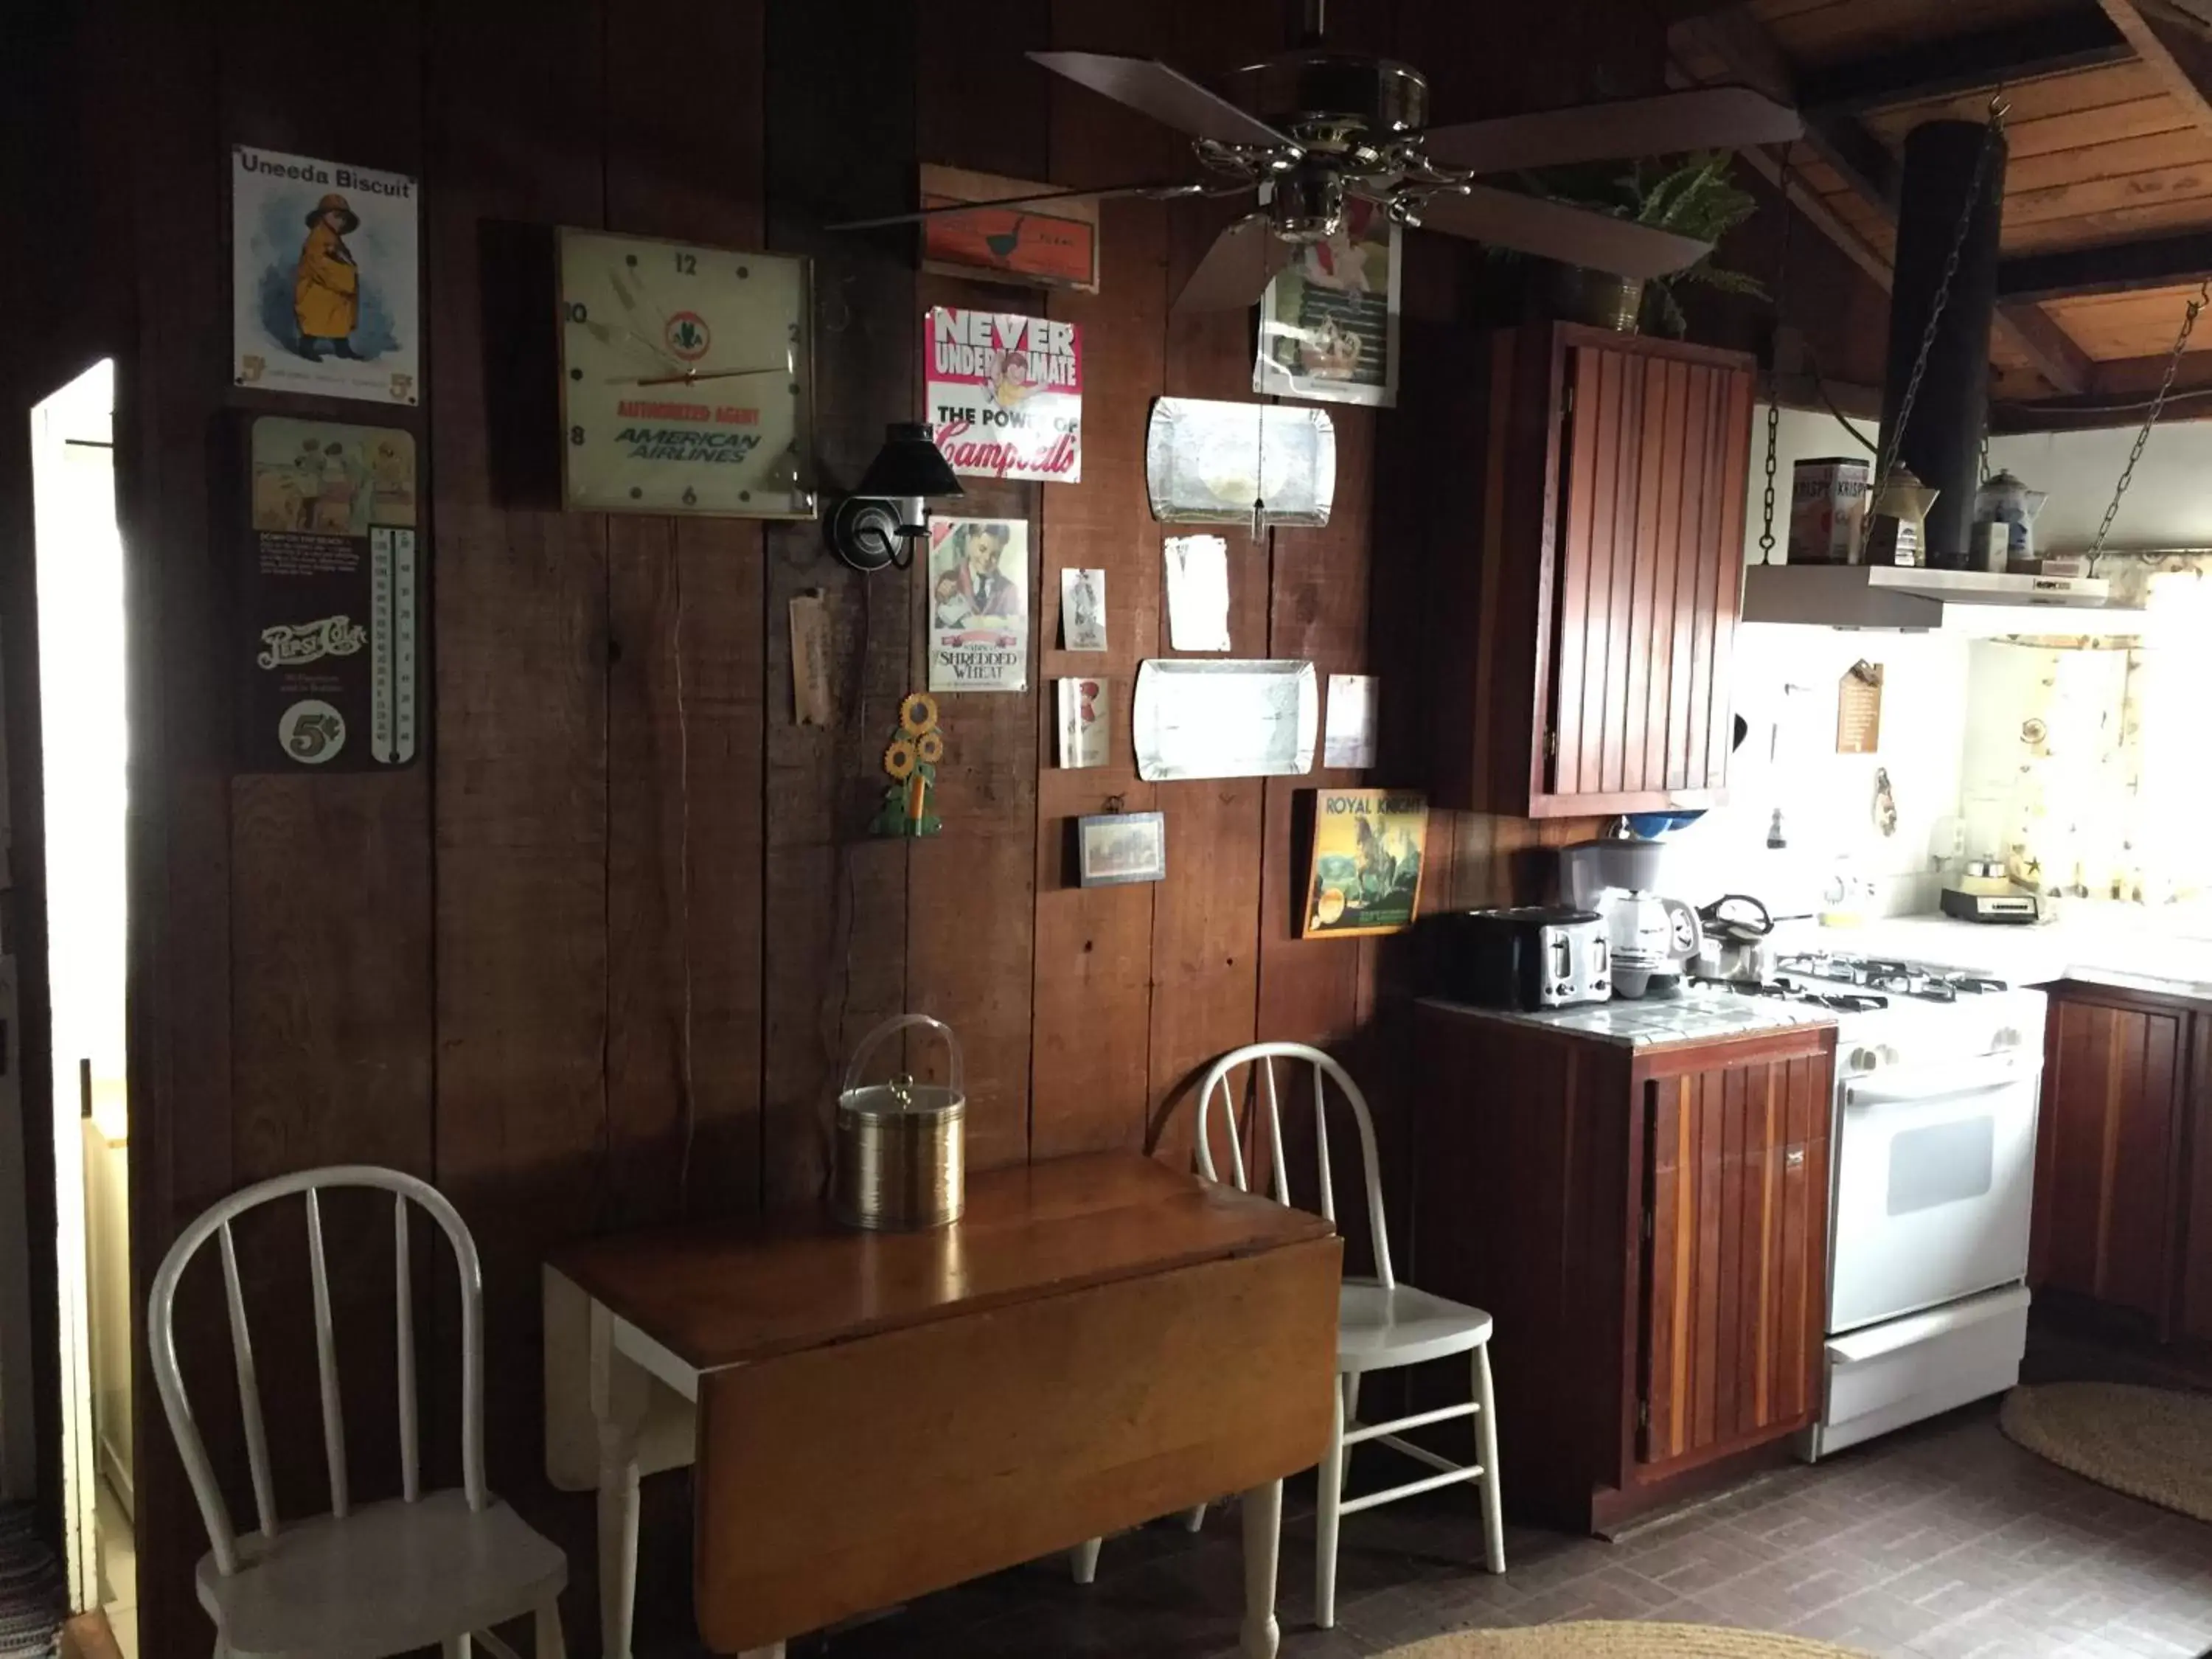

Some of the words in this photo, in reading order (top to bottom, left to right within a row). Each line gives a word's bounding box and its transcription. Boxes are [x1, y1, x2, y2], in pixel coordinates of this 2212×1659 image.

[241, 154, 329, 184] Uneeda
[336, 169, 411, 198] Biscuit
[675, 253, 697, 276] 12
[564, 302, 587, 324] 10
[788, 324, 801, 344] 2
[934, 307, 1076, 357] NEVER
[936, 341, 1077, 386] UNDERIMATE
[938, 406, 975, 425] THE
[983, 409, 1040, 430] POW
[571, 425, 585, 447] 8
[614, 428, 762, 450] AMERICAN
[787, 437, 799, 454] 4
[627, 445, 748, 465] AIRLINES
[682, 486, 697, 506] 6
[941, 651, 1017, 667] SHREDDED
[953, 665, 1004, 680] WHEAT
[1326, 797, 1371, 814] ROYAL
